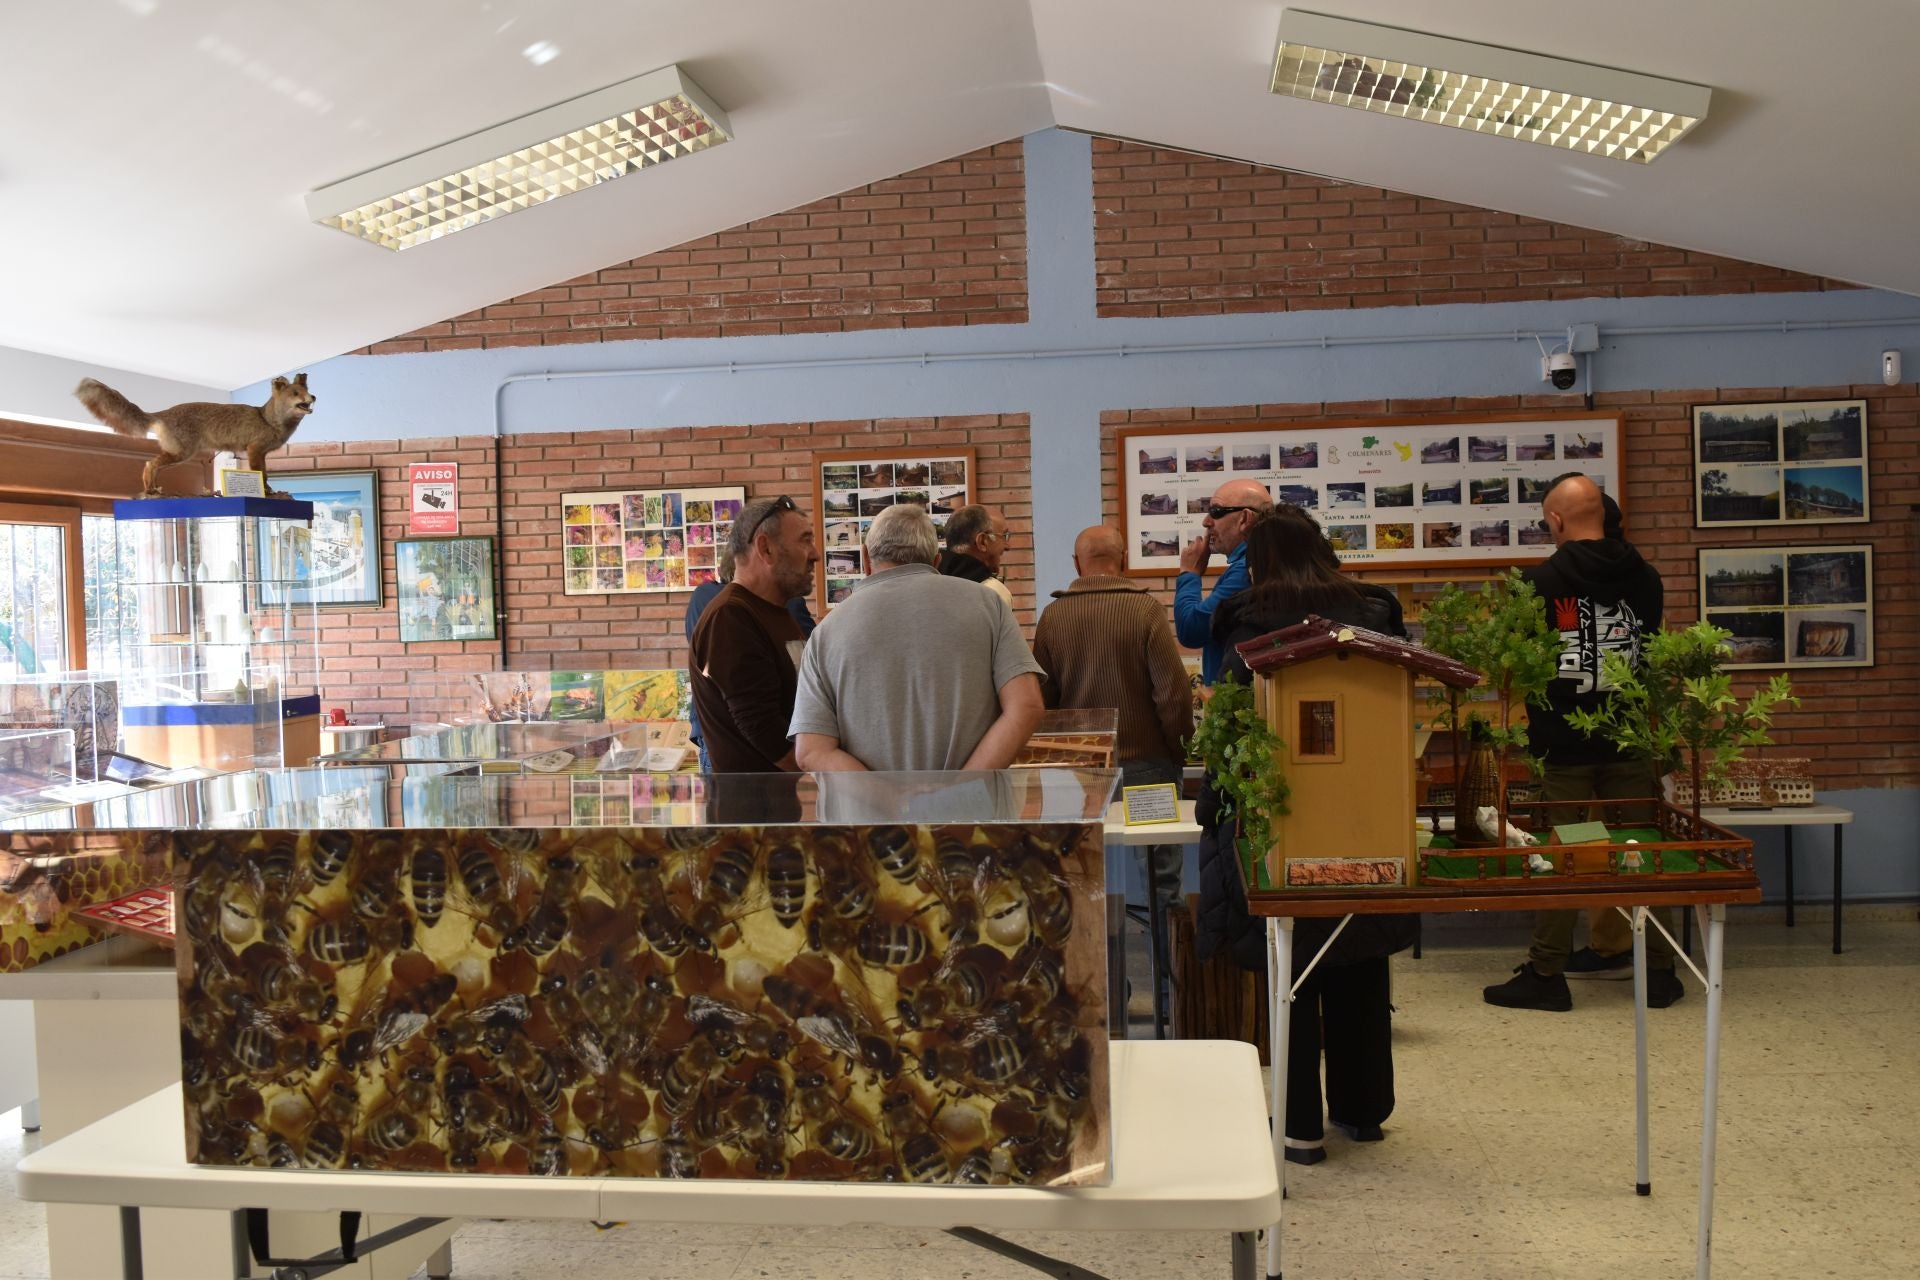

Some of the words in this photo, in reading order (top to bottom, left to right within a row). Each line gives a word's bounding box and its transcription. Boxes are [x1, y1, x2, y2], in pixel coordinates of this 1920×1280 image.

[1347, 449, 1392, 457] COLMENARES
[415, 470, 452, 480] AVISO
[1578, 596, 1594, 672] パフォーマンス
